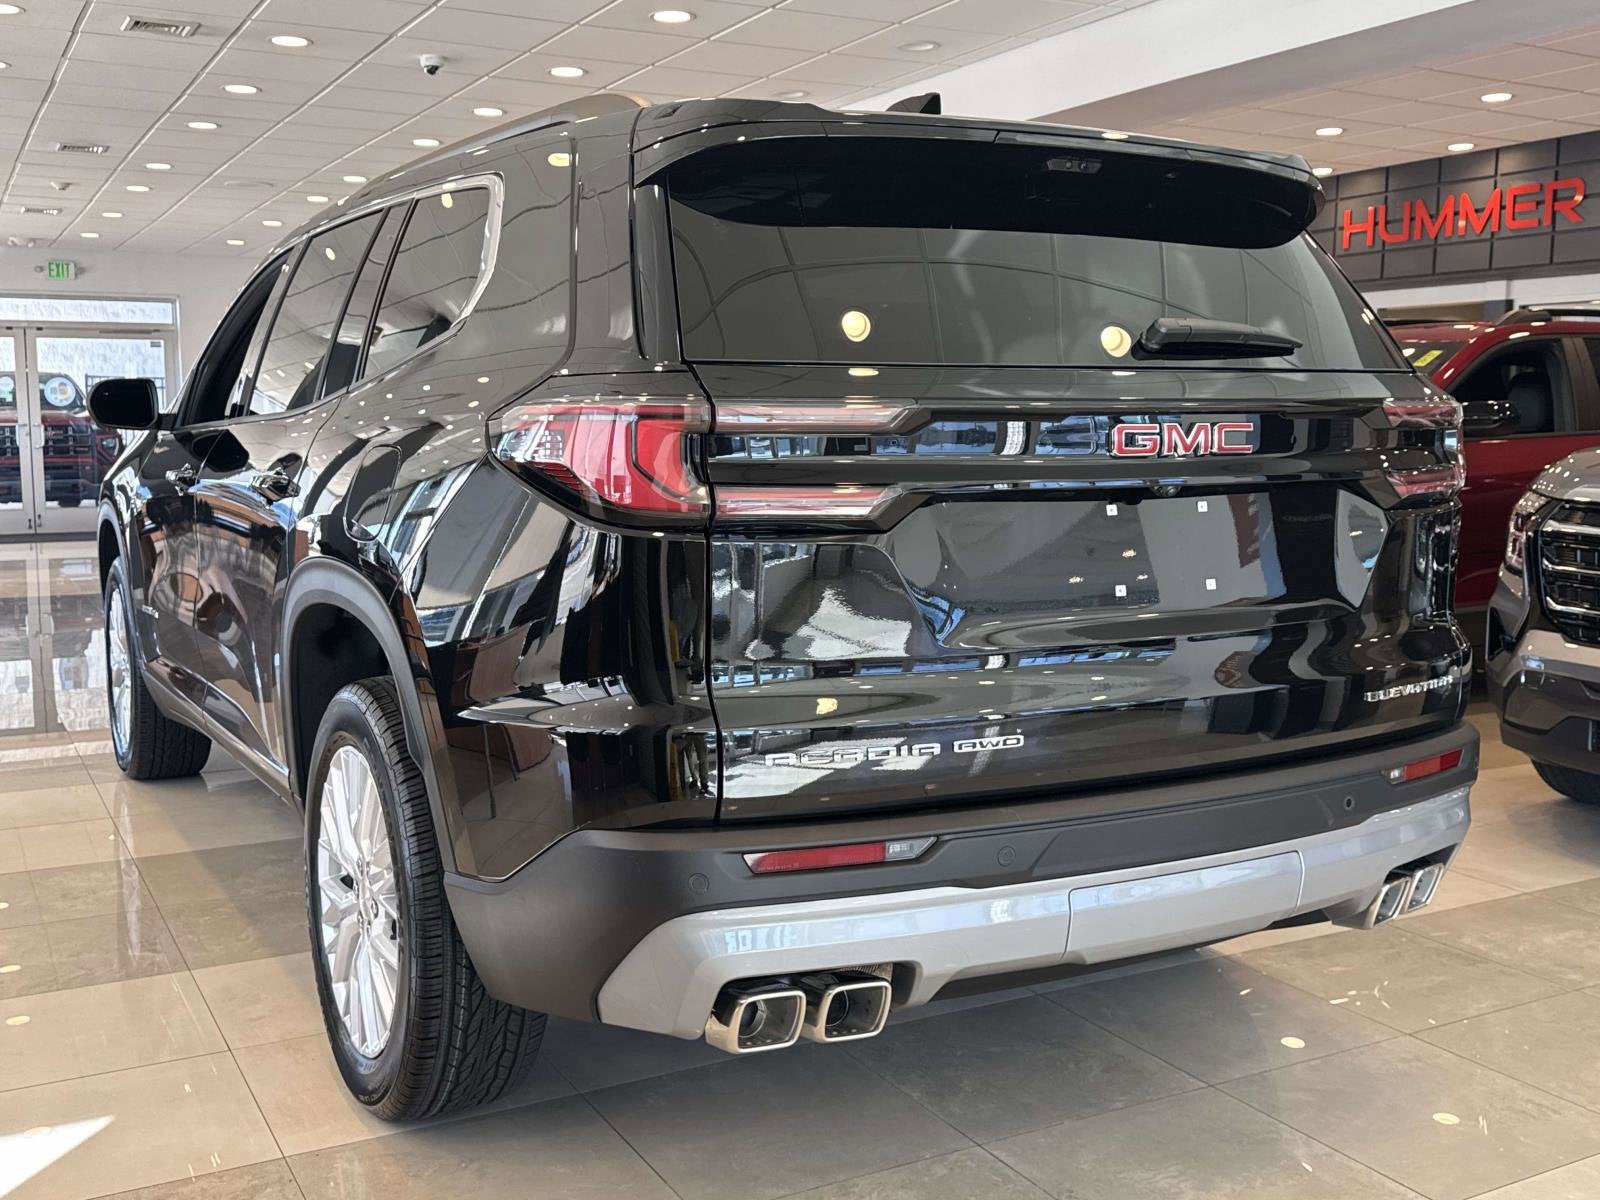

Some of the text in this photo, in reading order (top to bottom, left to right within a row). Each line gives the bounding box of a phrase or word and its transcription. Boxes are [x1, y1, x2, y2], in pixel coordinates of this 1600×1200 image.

[1342, 177, 1586, 249] HUMMER
[48, 261, 70, 279] EXIT
[1112, 422, 1254, 456] GMC
[765, 735, 1024, 766] ACADIA AWD
